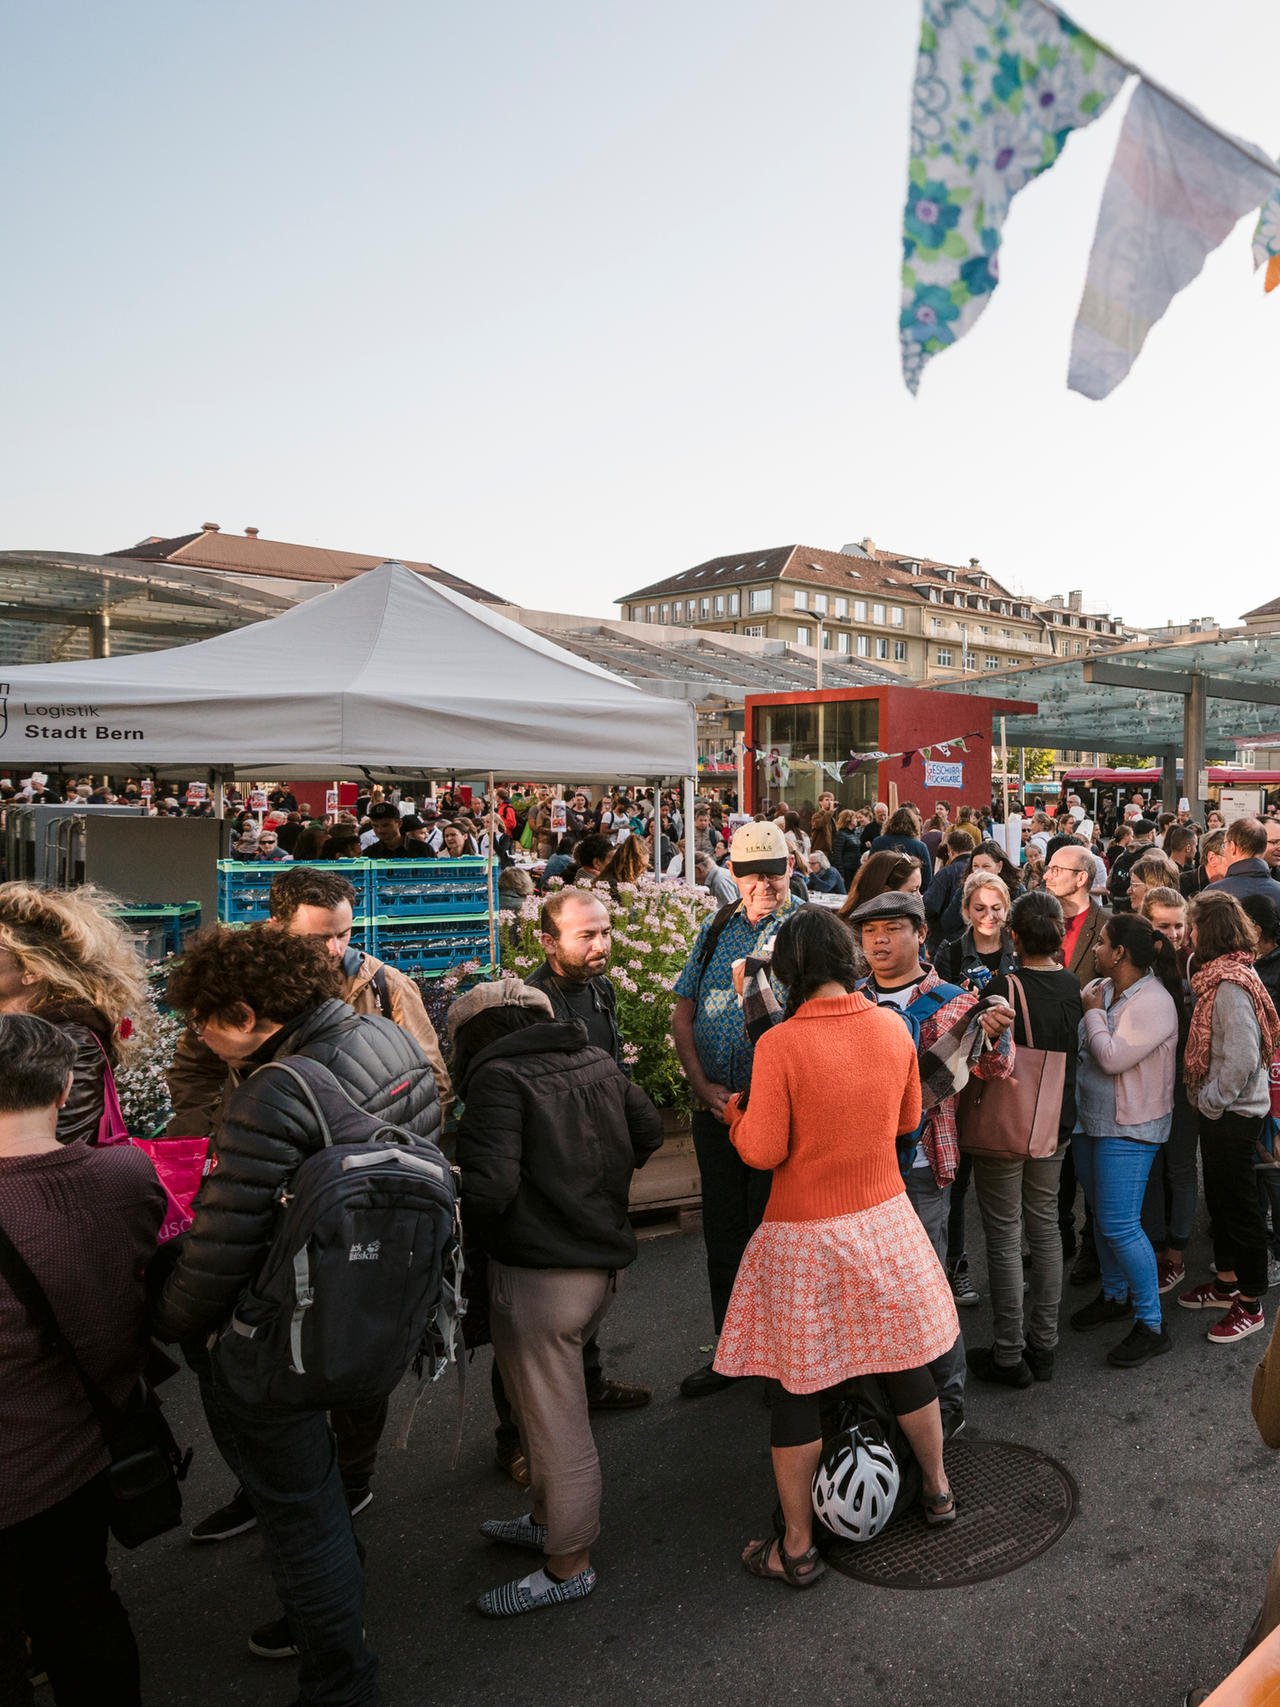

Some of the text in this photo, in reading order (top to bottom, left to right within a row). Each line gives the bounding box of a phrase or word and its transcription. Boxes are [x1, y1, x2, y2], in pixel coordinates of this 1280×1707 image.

[24, 703, 100, 718] Logistik
[25, 725, 144, 740] Stadt Bern
